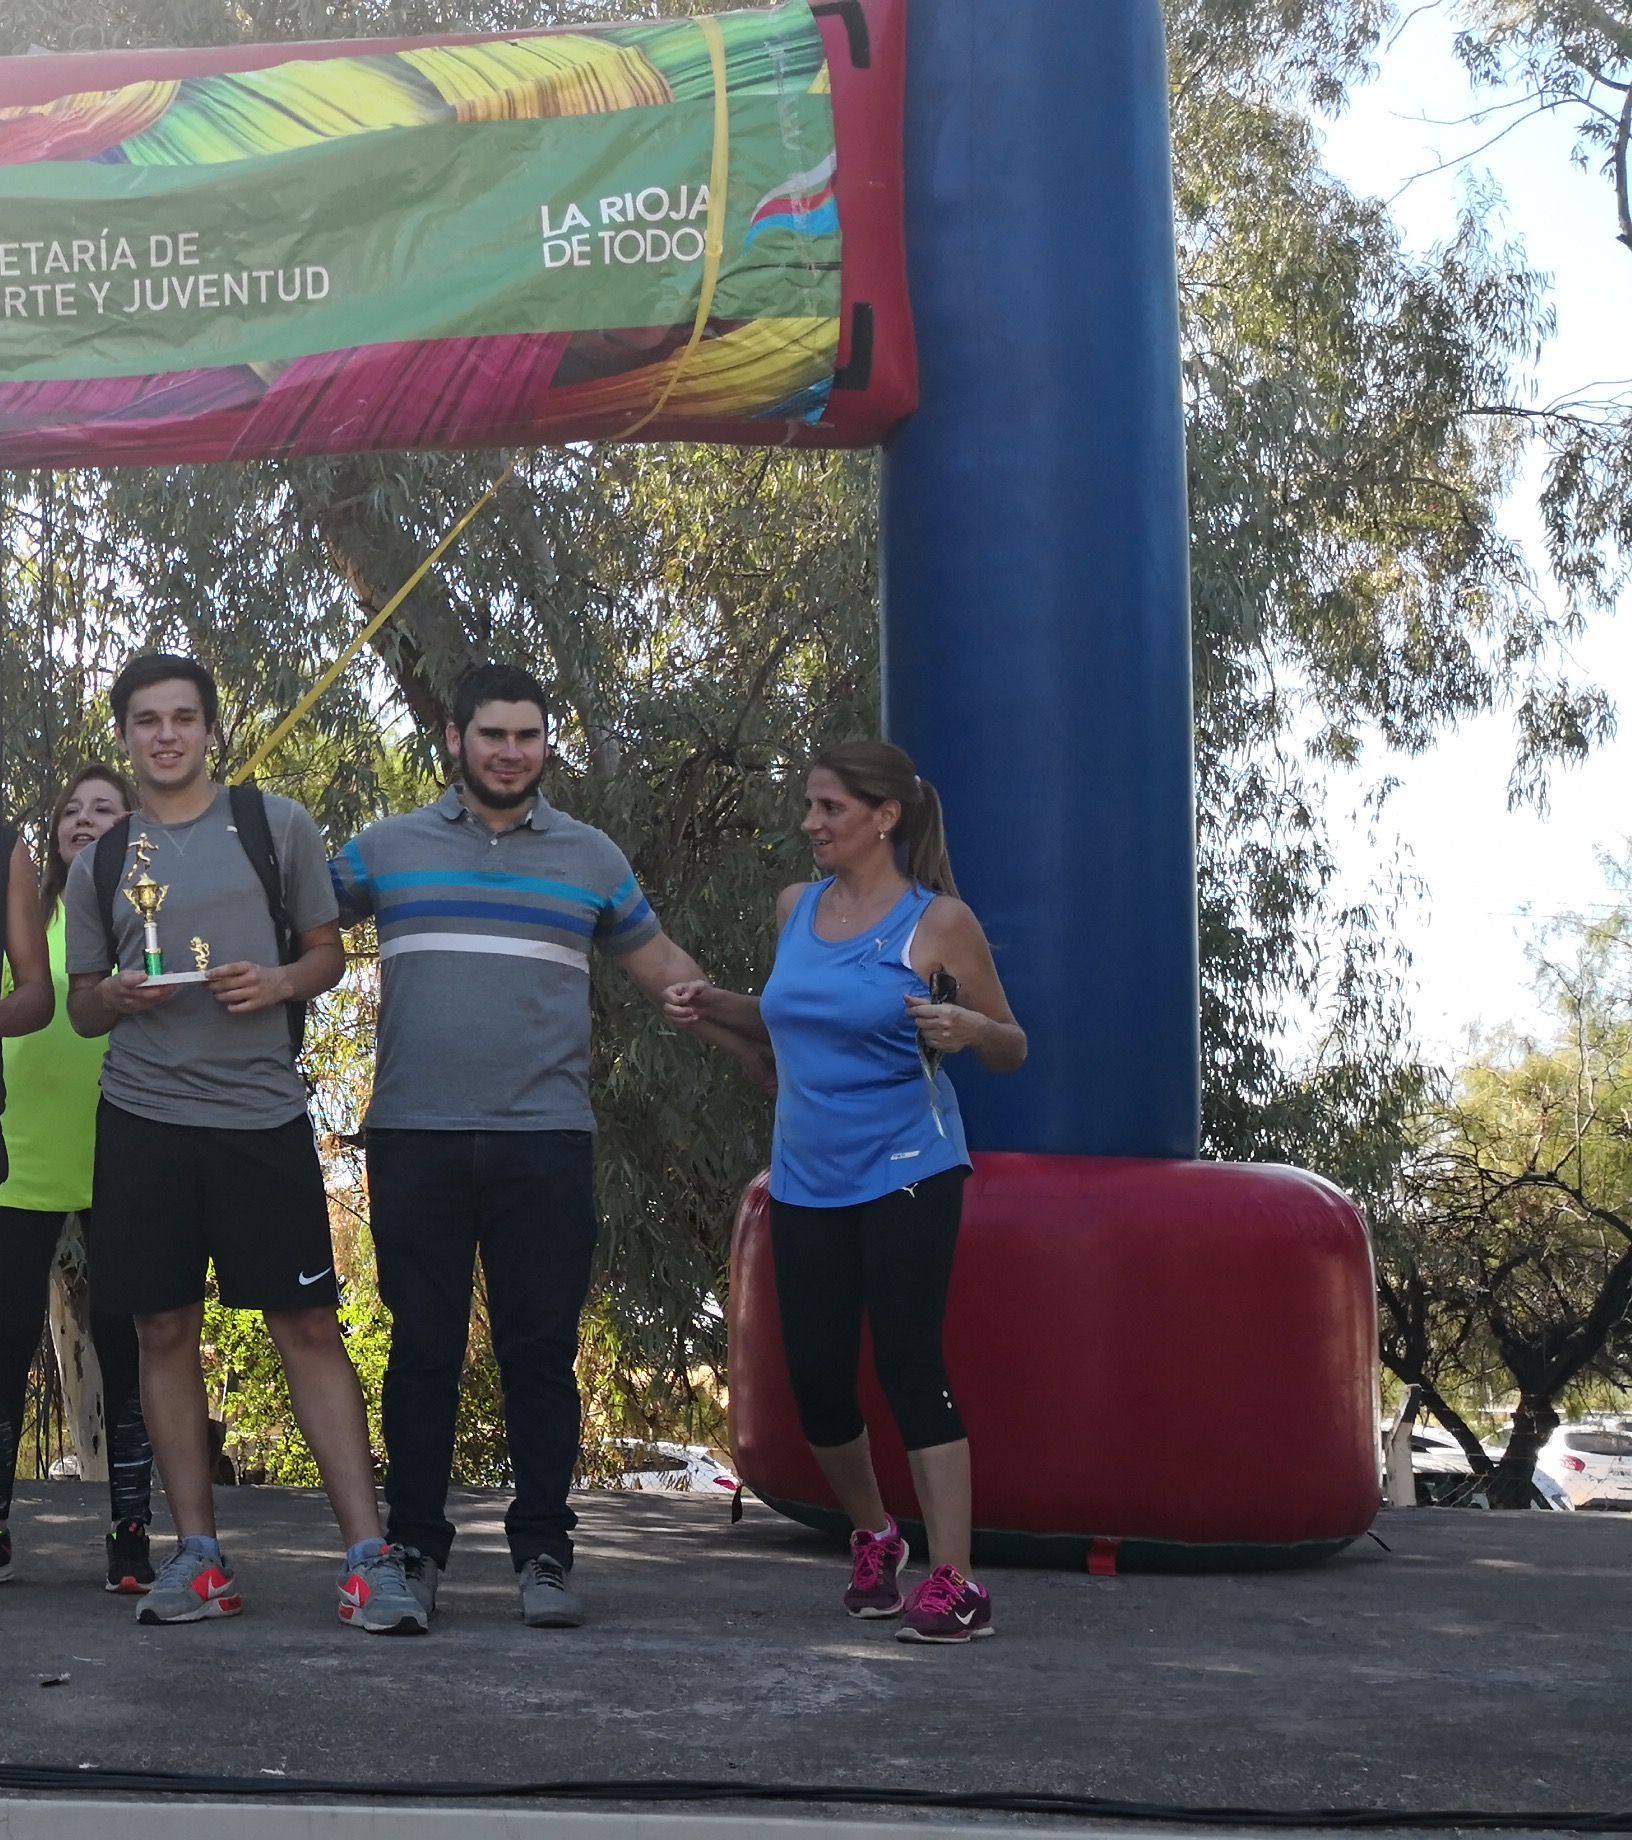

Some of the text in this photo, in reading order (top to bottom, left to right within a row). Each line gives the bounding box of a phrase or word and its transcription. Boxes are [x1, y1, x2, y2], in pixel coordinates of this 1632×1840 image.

[541, 184, 711, 238] LA RIOJA
[150, 232, 200, 268] DE
[542, 234, 591, 268] DE
[88, 281, 111, 314] Y
[122, 266, 330, 313] JUVENTUD
